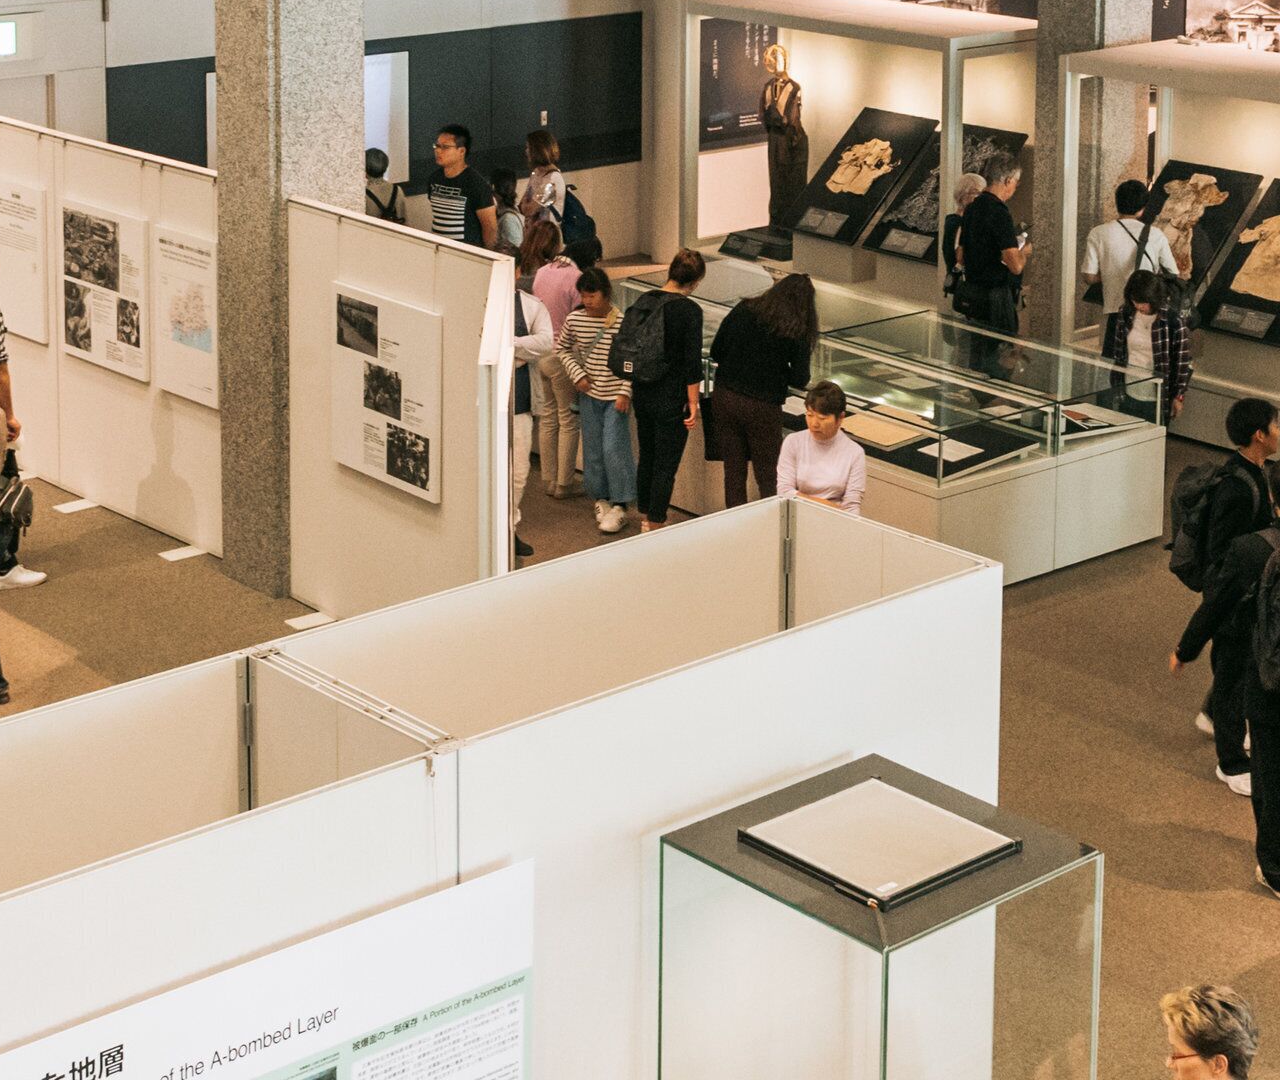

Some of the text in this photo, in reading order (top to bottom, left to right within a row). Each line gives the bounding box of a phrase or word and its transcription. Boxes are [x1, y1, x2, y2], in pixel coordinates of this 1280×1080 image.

[422, 1014, 428, 1022] A
[180, 1061, 206, 1080] the
[210, 1021, 292, 1070] A-bombed
[297, 1007, 340, 1035] Layer
